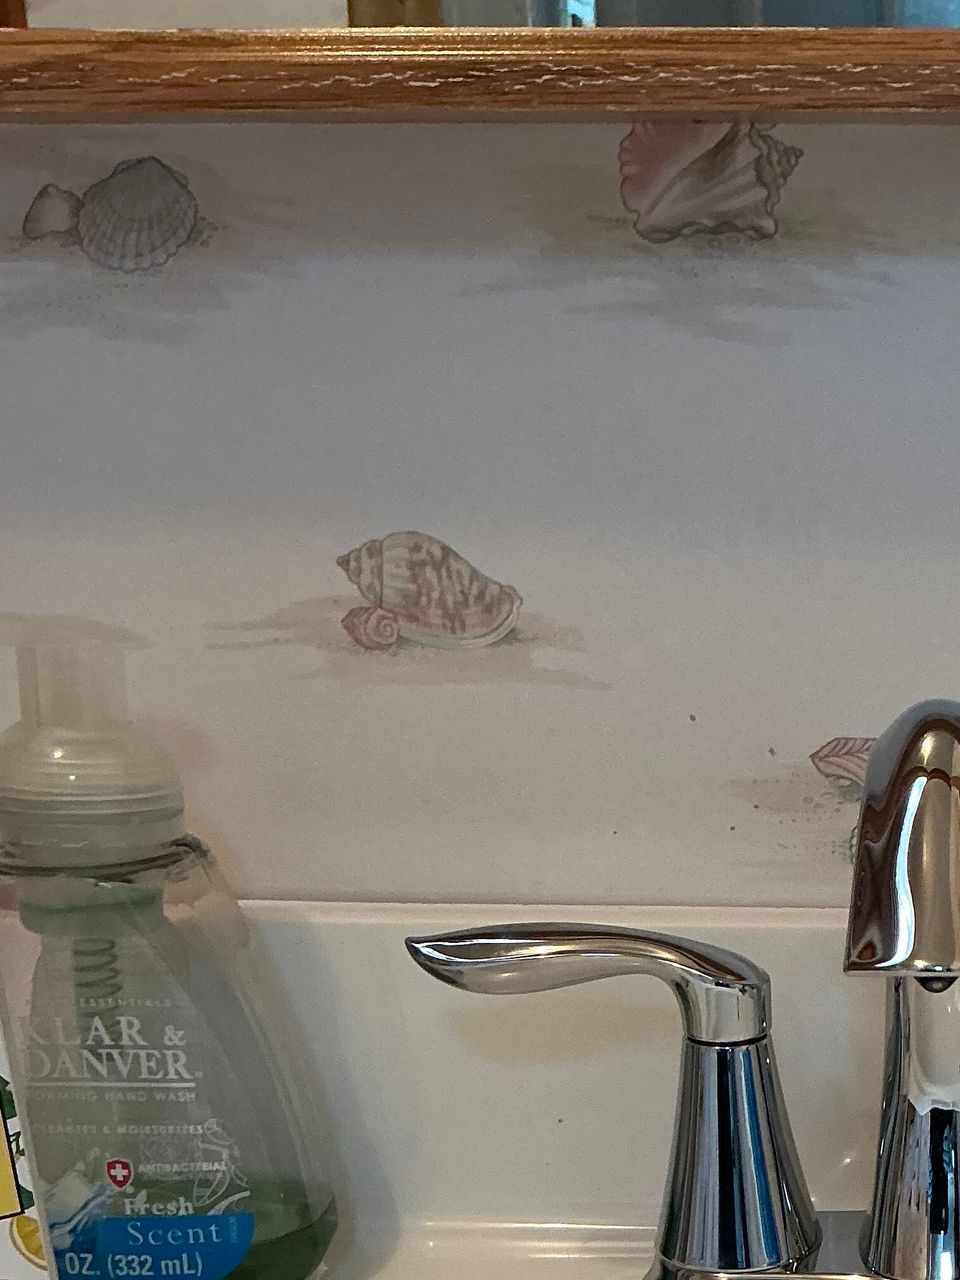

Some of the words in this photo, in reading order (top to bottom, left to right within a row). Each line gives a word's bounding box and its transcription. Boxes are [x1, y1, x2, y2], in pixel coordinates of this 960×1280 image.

[163, 1025, 187, 1046] &
[23, 1049, 195, 1079] DANVER
[154, 1091, 197, 1102] WASH
[124, 1196, 195, 1216] Fresh
[127, 1221, 223, 1245] Scent
[65, 1252, 101, 1275] OZ.
[107, 1253, 154, 1278] (332
[161, 1252, 203, 1277] mL)
